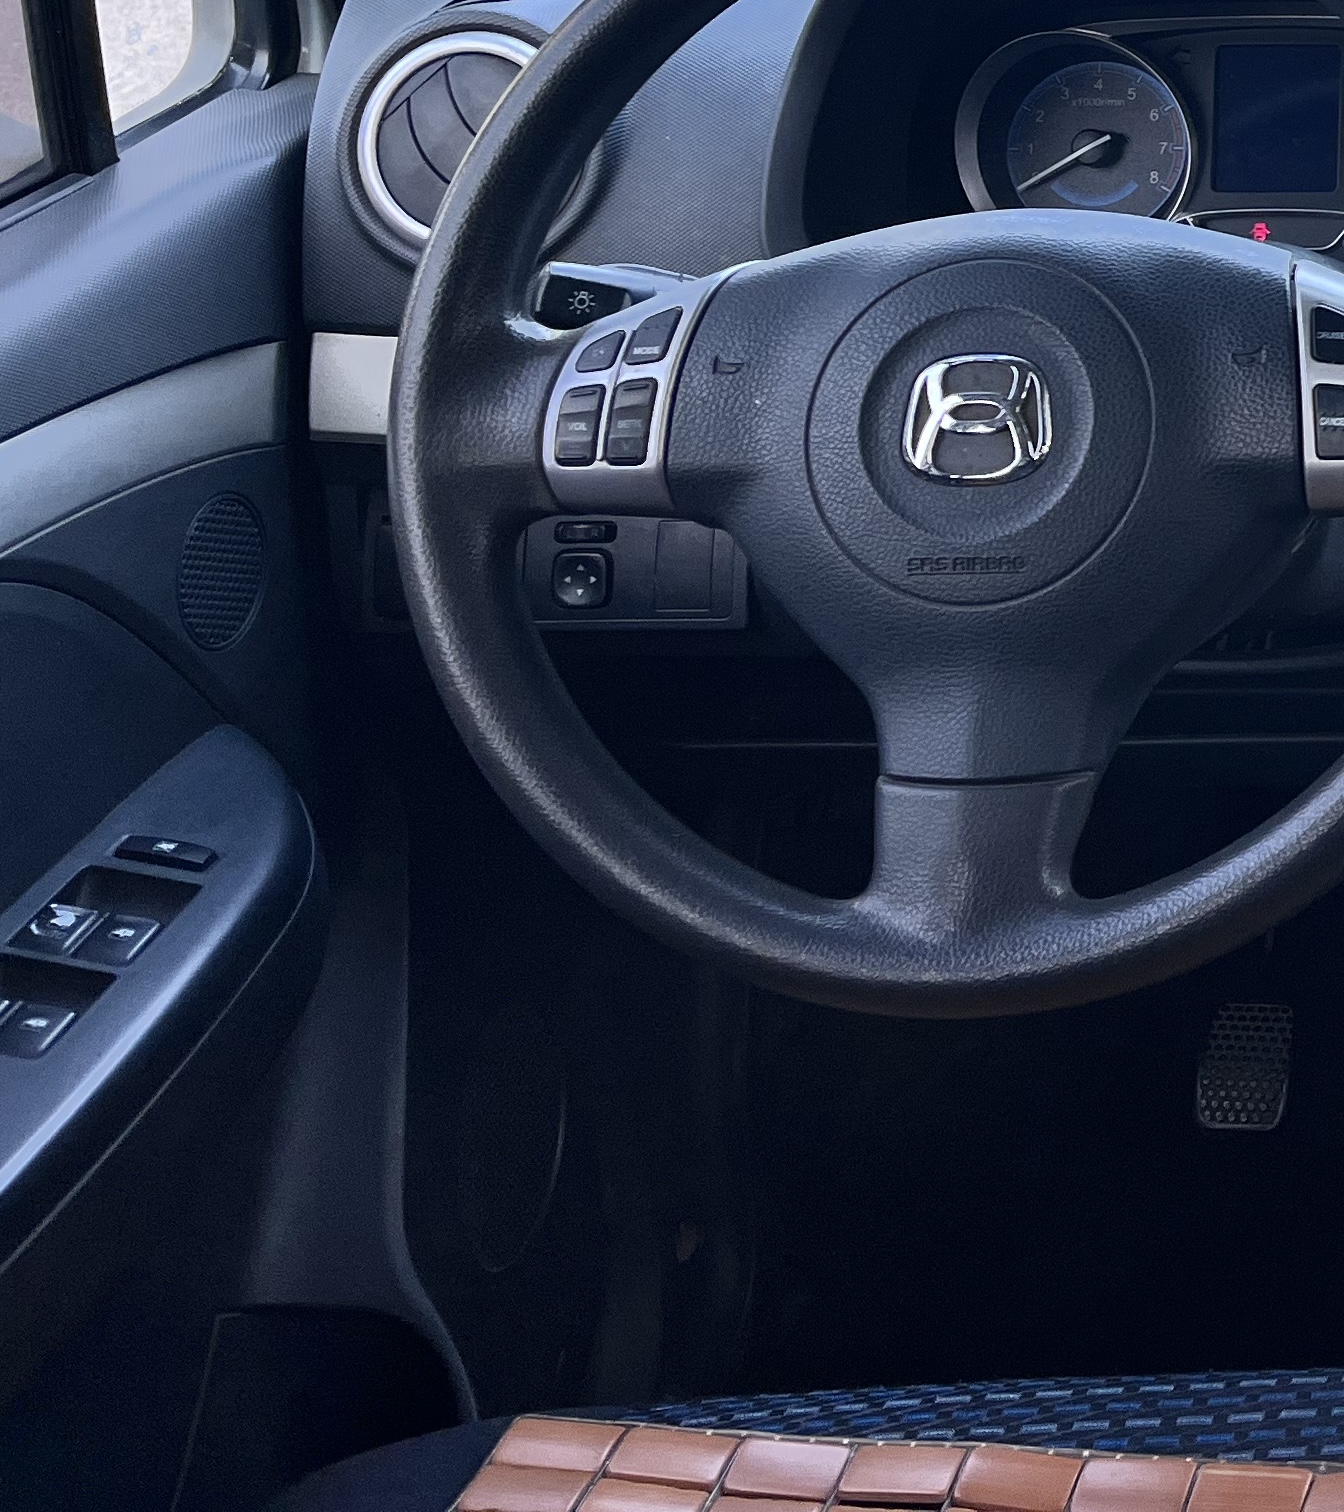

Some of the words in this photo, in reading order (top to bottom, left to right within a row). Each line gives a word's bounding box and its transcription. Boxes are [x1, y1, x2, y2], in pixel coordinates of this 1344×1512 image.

[1061, 88, 1070, 100] 3
[1127, 88, 1137, 101] 5
[1036, 110, 1045, 123] 2
[1150, 109, 1159, 121] 6
[1028, 144, 1033, 154] 1
[1159, 142, 1169, 154] 7
[1150, 171, 1159, 184] 8
